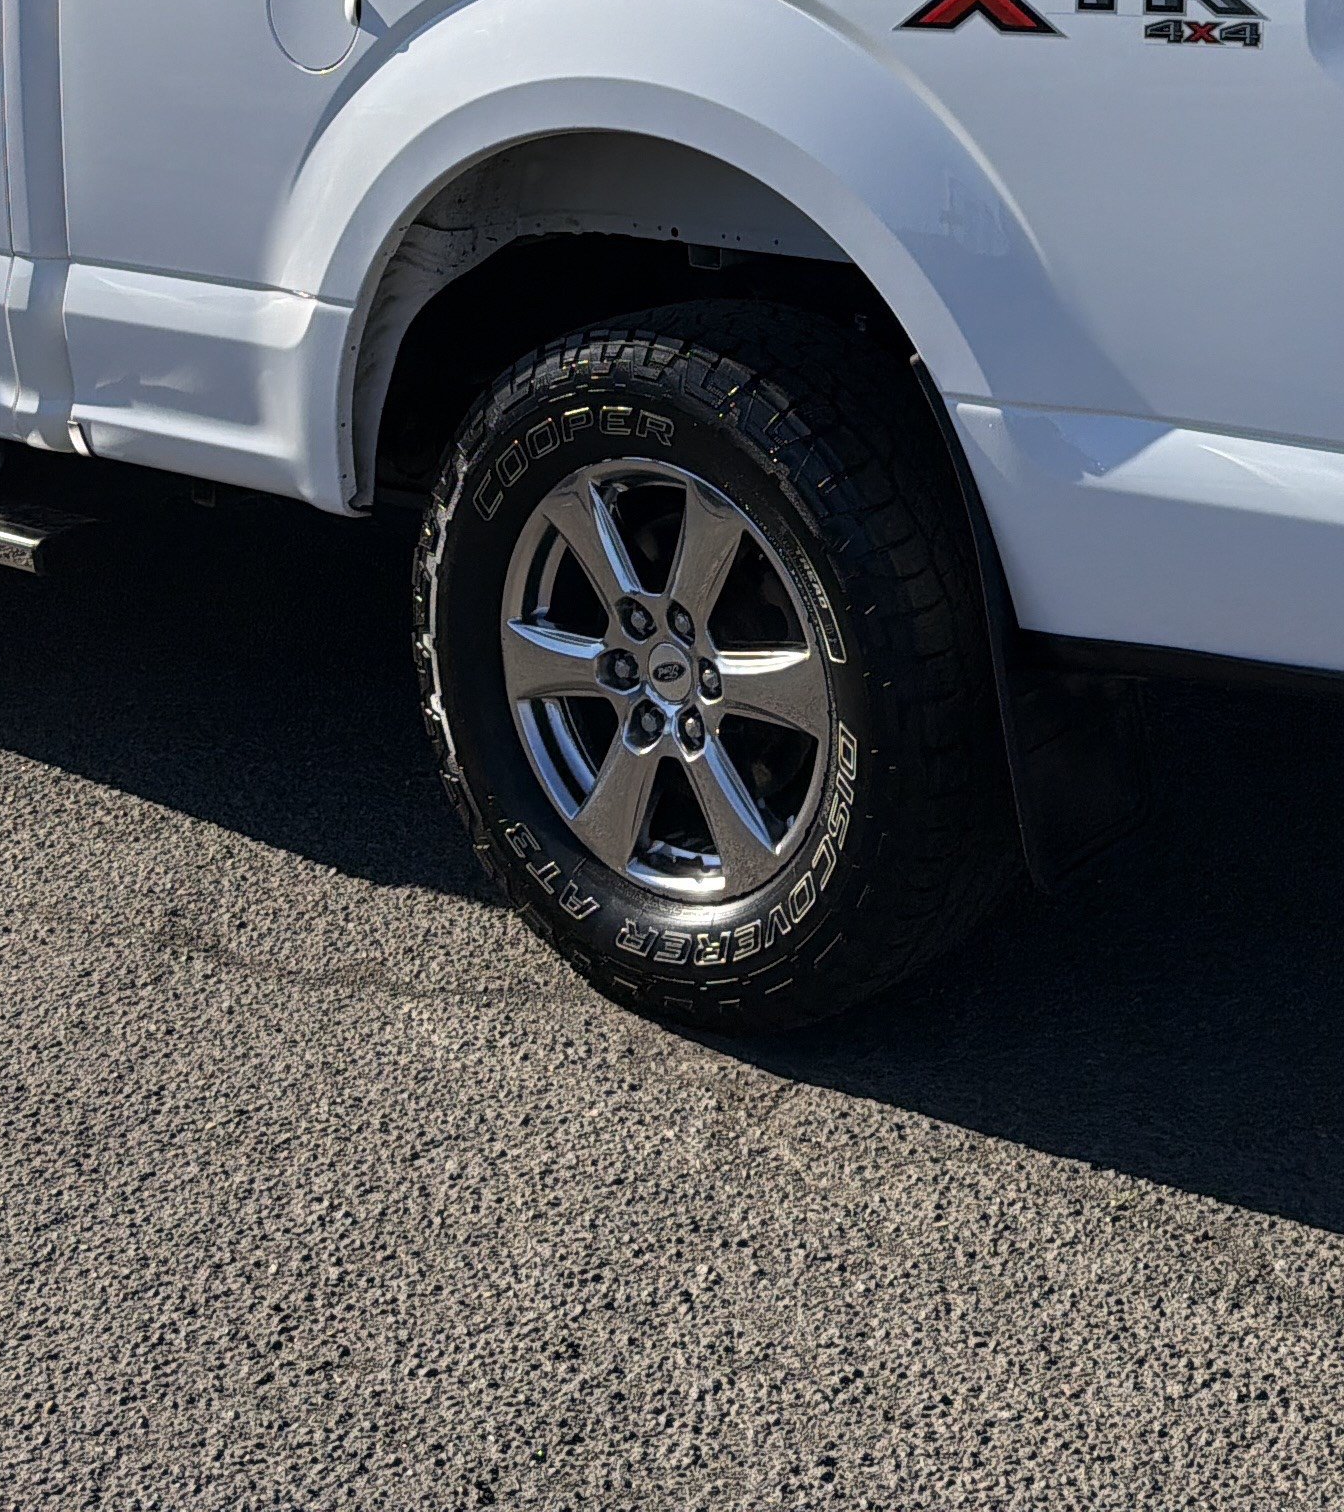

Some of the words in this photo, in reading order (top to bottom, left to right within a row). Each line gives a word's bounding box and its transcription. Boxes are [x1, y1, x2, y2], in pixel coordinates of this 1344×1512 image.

[1144, 20, 1262, 49] 4x4
[472, 405, 675, 522] COOPER
[504, 822, 601, 920] AT3
[615, 719, 857, 966] DISCOVERER
